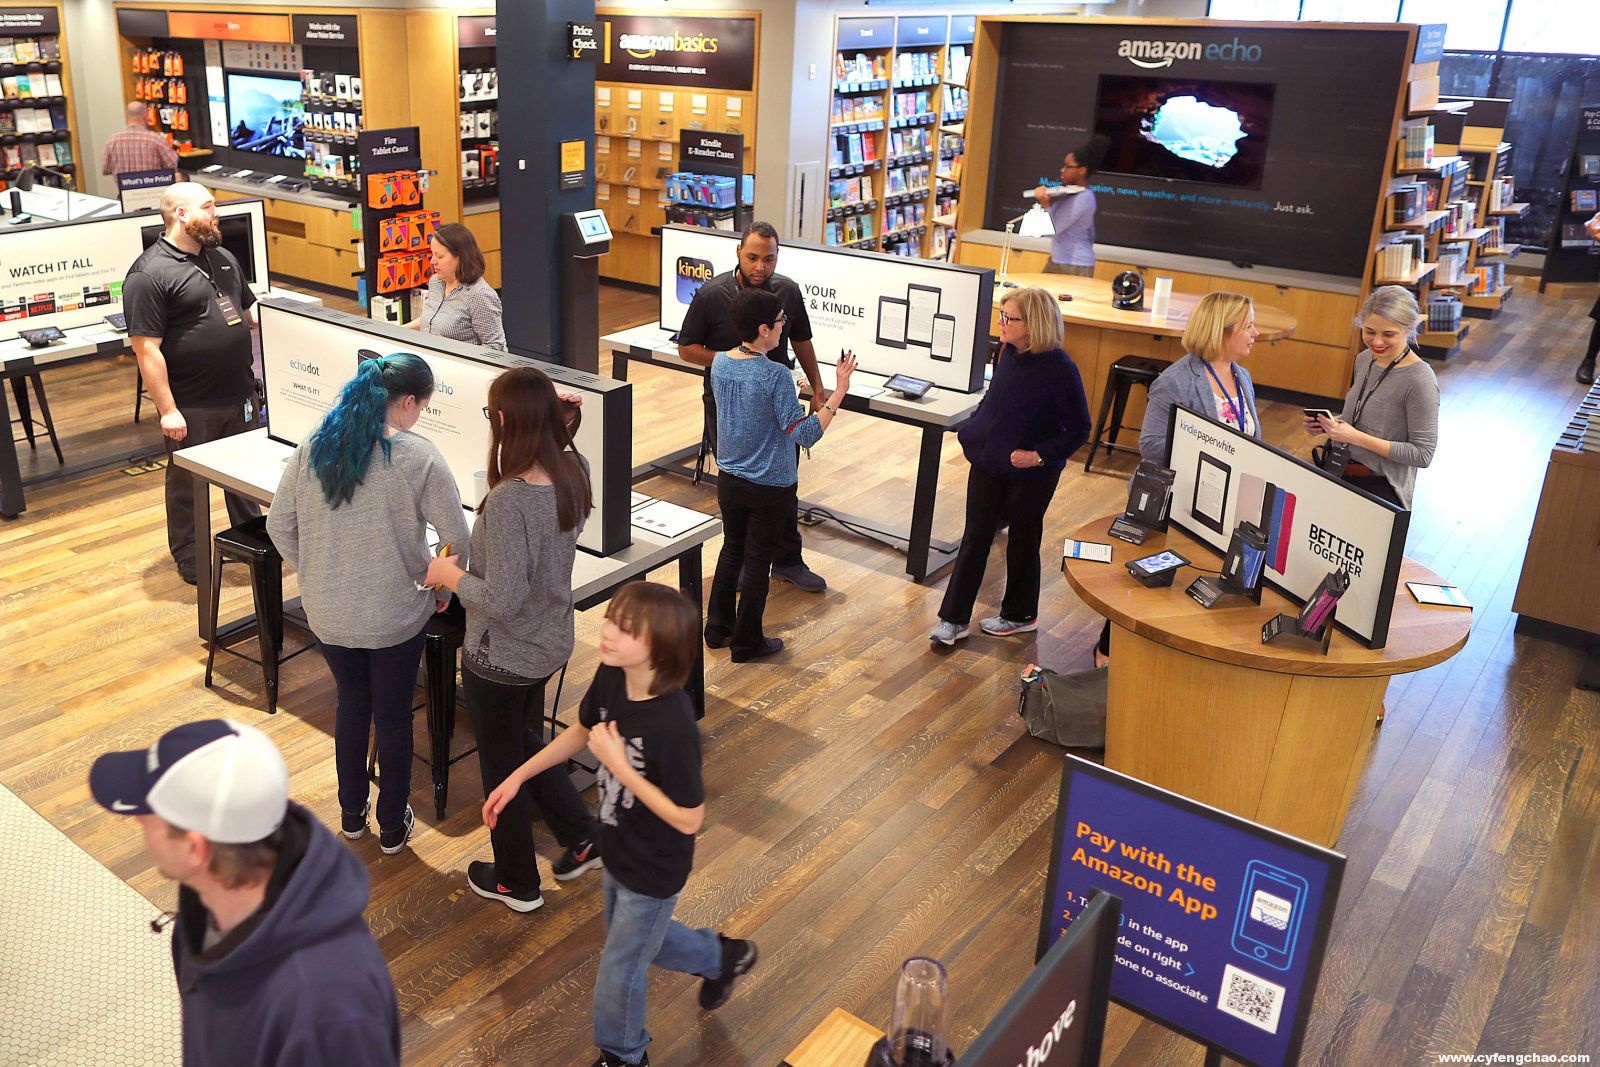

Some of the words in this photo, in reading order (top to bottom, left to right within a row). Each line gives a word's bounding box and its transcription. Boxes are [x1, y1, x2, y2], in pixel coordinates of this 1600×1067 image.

[573, 25, 592, 36] Price
[573, 38, 597, 49] Check
[1118, 40, 1202, 60] amazon
[1206, 38, 1262, 61] echo
[384, 137, 397, 145] Fire
[701, 139, 721, 148] Kindle
[372, 147, 391, 156] Tablet
[688, 147, 715, 157] E-Reader
[716, 150, 734, 159] Cases
[155, 175, 172, 183] Price?
[1117, 187, 1139, 197] news,
[1142, 191, 1178, 201] weather,
[1181, 193, 1197, 202] and
[1273, 200, 1293, 212] Just
[1296, 204, 1314, 214] ask.
[10, 262, 53, 278] WATCH
[57, 261, 67, 271] IT
[72, 258, 93, 269] ALL
[678, 260, 712, 280] kindle
[805, 284, 836, 299] YOUR
[31, 304, 53, 313] NETFLIX
[810, 299, 818, 309] &
[822, 301, 864, 318] KINDLE
[293, 382, 306, 390] WHAT
[1309, 523, 1364, 566] BETTER
[1308, 540, 1362, 578] TOGETHER
[1076, 821, 1116, 853] Pay
[1120, 842, 1171, 874] with
[1176, 863, 1216, 892] the
[1072, 848, 1163, 897] Amazon
[1168, 888, 1217, 920] App
[1066, 891, 1076, 902] 1.
[1256, 897, 1288, 912] amazon
[1128, 918, 1139, 930] in
[1142, 925, 1162, 941] the
[1165, 936, 1188, 952] app
[1134, 944, 1150, 956] on
[1153, 951, 1182, 971] right
[1141, 966, 1154, 978] to
[1155, 973, 1208, 1004] associate
